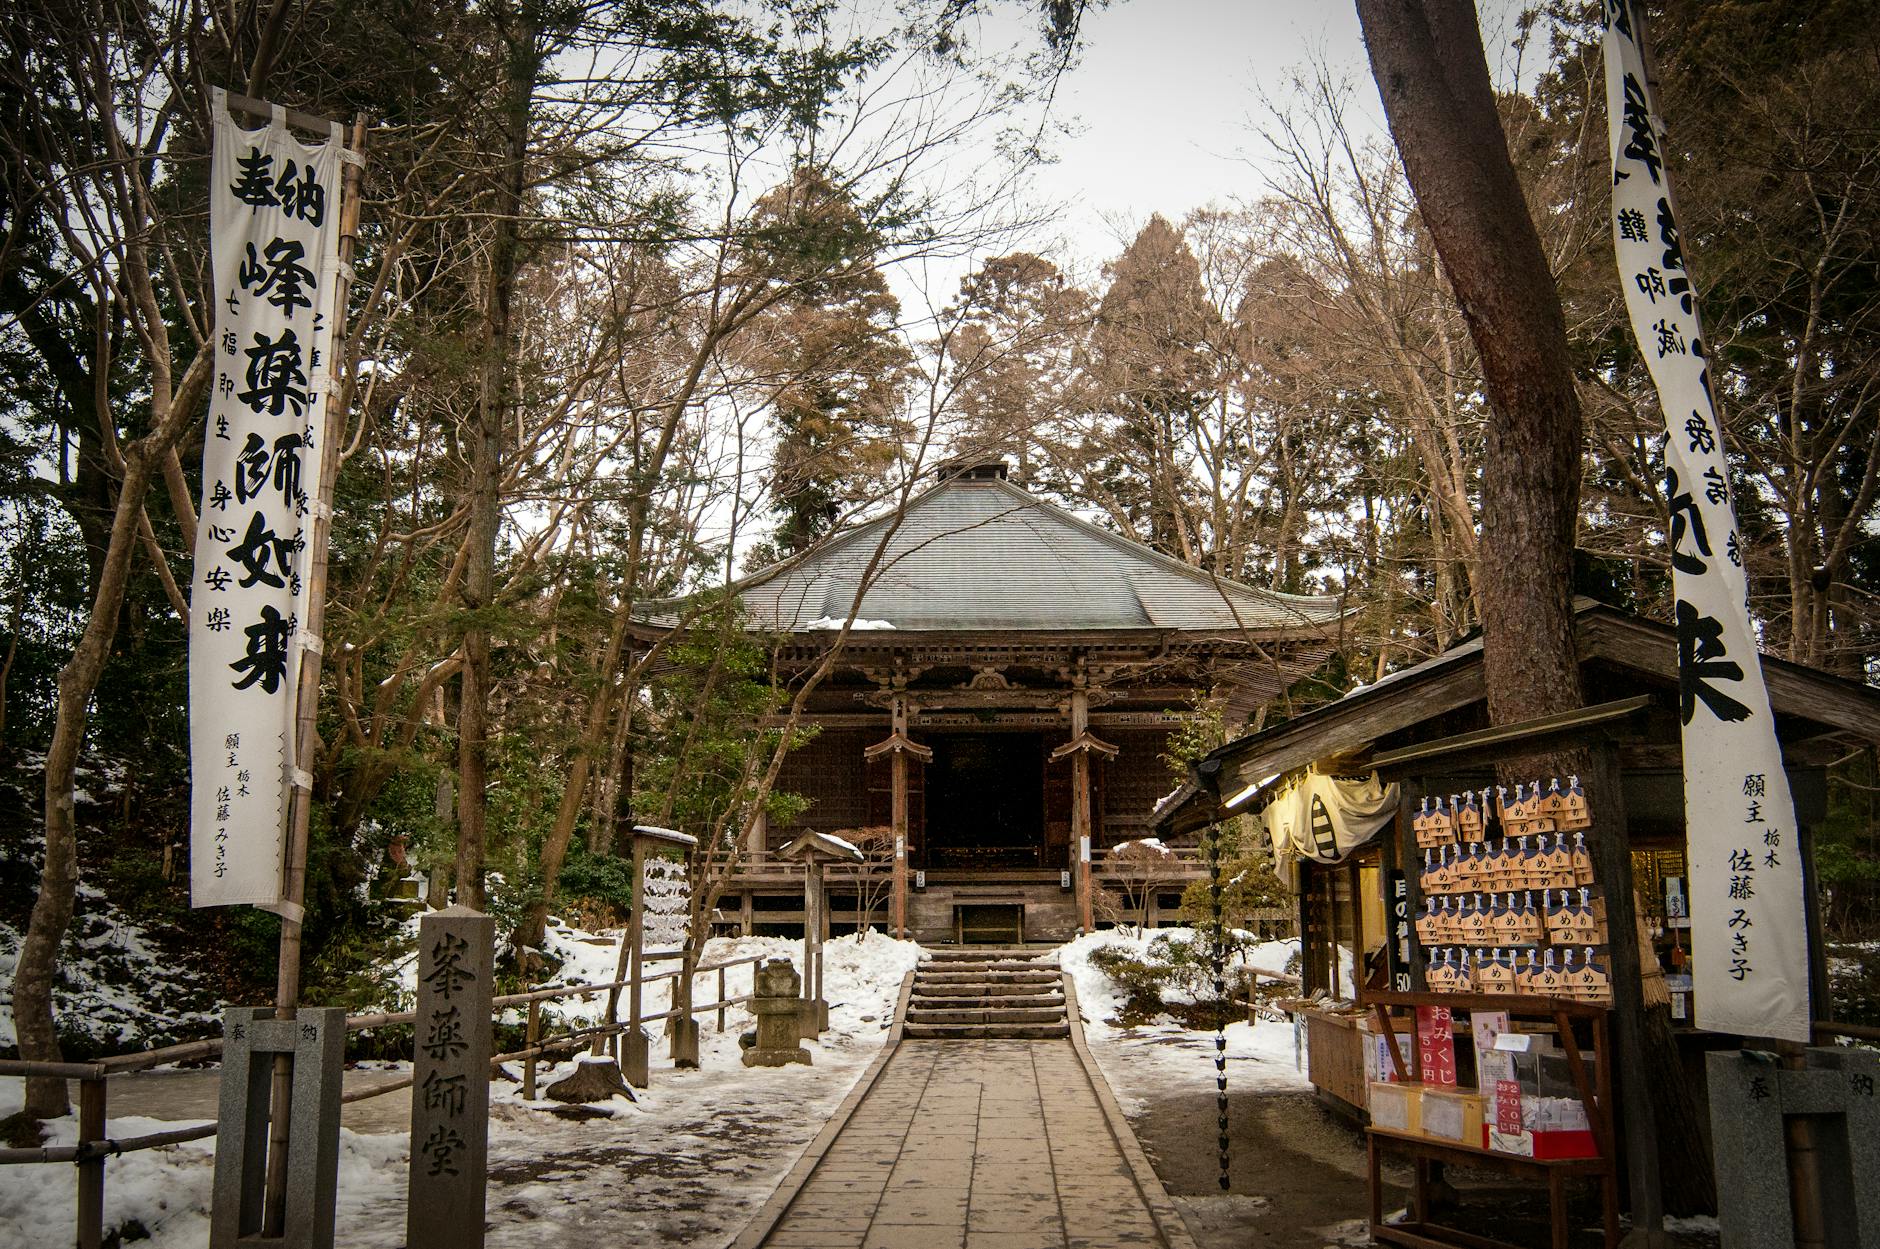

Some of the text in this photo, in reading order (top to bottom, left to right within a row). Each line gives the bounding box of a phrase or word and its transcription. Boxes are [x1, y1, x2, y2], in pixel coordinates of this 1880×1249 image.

[231, 147, 324, 228] 奉納
[1552, 797, 1560, 808] め
[1742, 773, 1766, 824] 願主
[1515, 806, 1523, 816] め
[1520, 823, 1528, 833] め
[1763, 828, 1781, 868] 栃木
[1469, 861, 1478, 871] め
[1536, 858, 1546, 868] め
[1439, 872, 1448, 881] め
[1472, 878, 1480, 888] め
[1426, 920, 1434, 928] め
[1473, 917, 1482, 926] め
[1506, 916, 1515, 926] め
[1560, 914, 1570, 925] め
[1511, 932, 1520, 942] め
[1563, 930, 1573, 940] め
[1443, 969, 1452, 978] め
[1492, 968, 1501, 977] め
[1583, 972, 1593, 983] め
[1545, 974, 1554, 984] め
[1496, 983, 1505, 992] め
[1432, 1006, 1454, 1084] おみくじ
[1423, 1036, 1434, 1080] 50円
[1497, 1084, 1508, 1131] おみくじ
[1510, 1085, 1520, 1133] 200円
